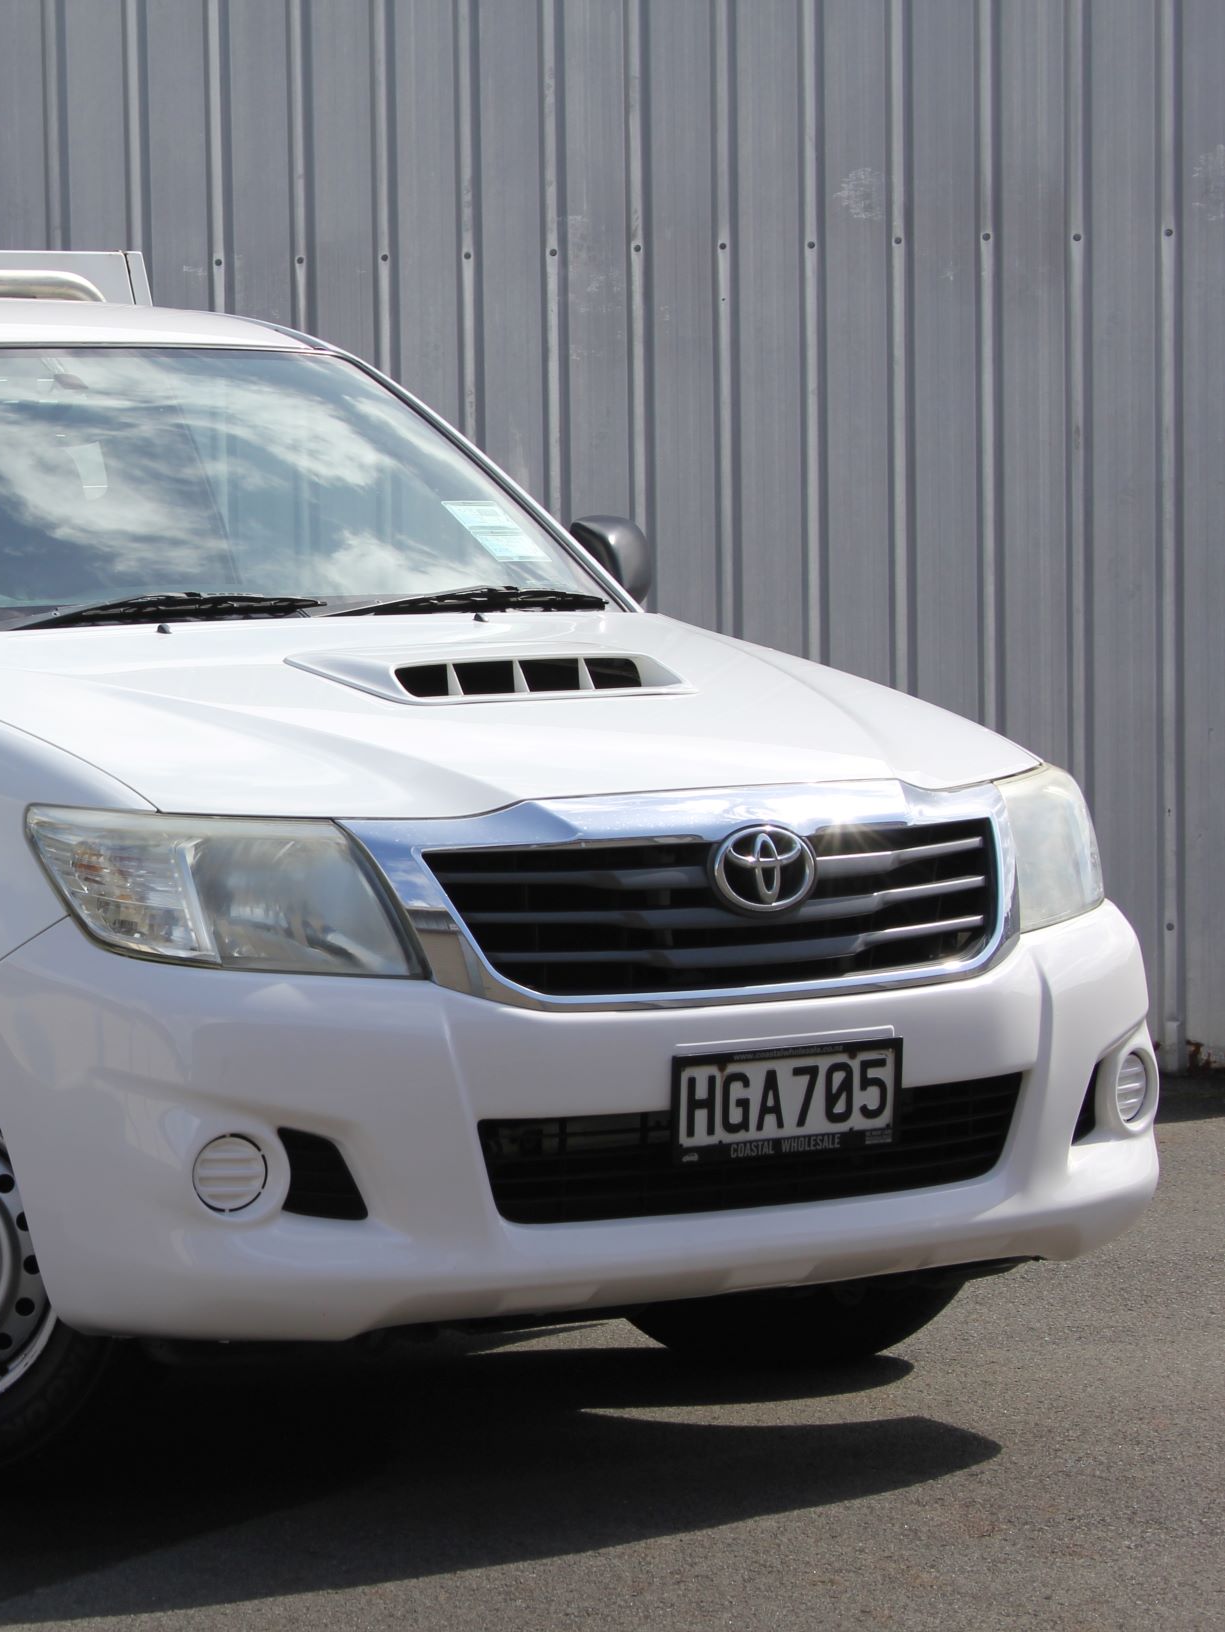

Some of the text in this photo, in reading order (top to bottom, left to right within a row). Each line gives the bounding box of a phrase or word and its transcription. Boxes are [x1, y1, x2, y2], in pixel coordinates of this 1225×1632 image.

[686, 1057, 888, 1138] HGA705
[730, 1134, 841, 1159] COASTAL WHOLESALE
